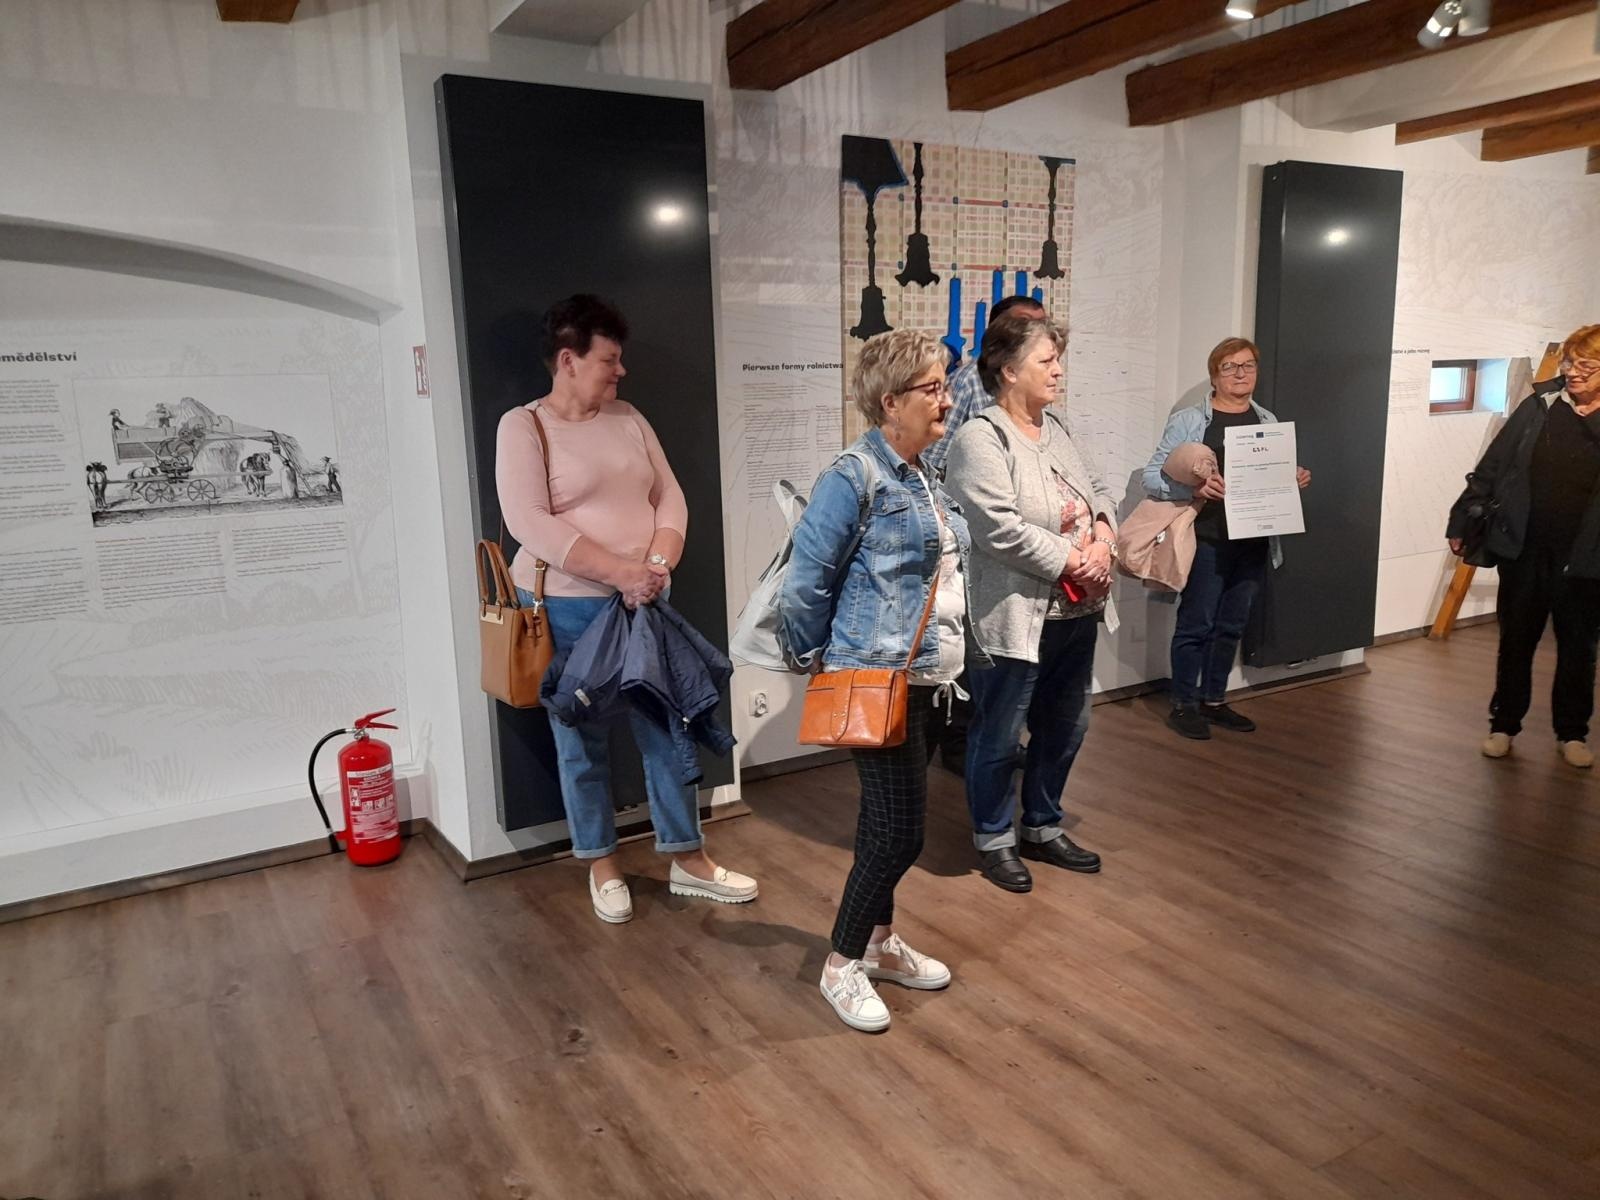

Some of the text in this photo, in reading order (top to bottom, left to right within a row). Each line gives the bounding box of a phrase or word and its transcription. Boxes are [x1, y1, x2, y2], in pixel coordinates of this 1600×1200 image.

[0, 351, 77, 362] mědělství
[742, 361, 844, 372] Pierwsze formy rolnictwa
